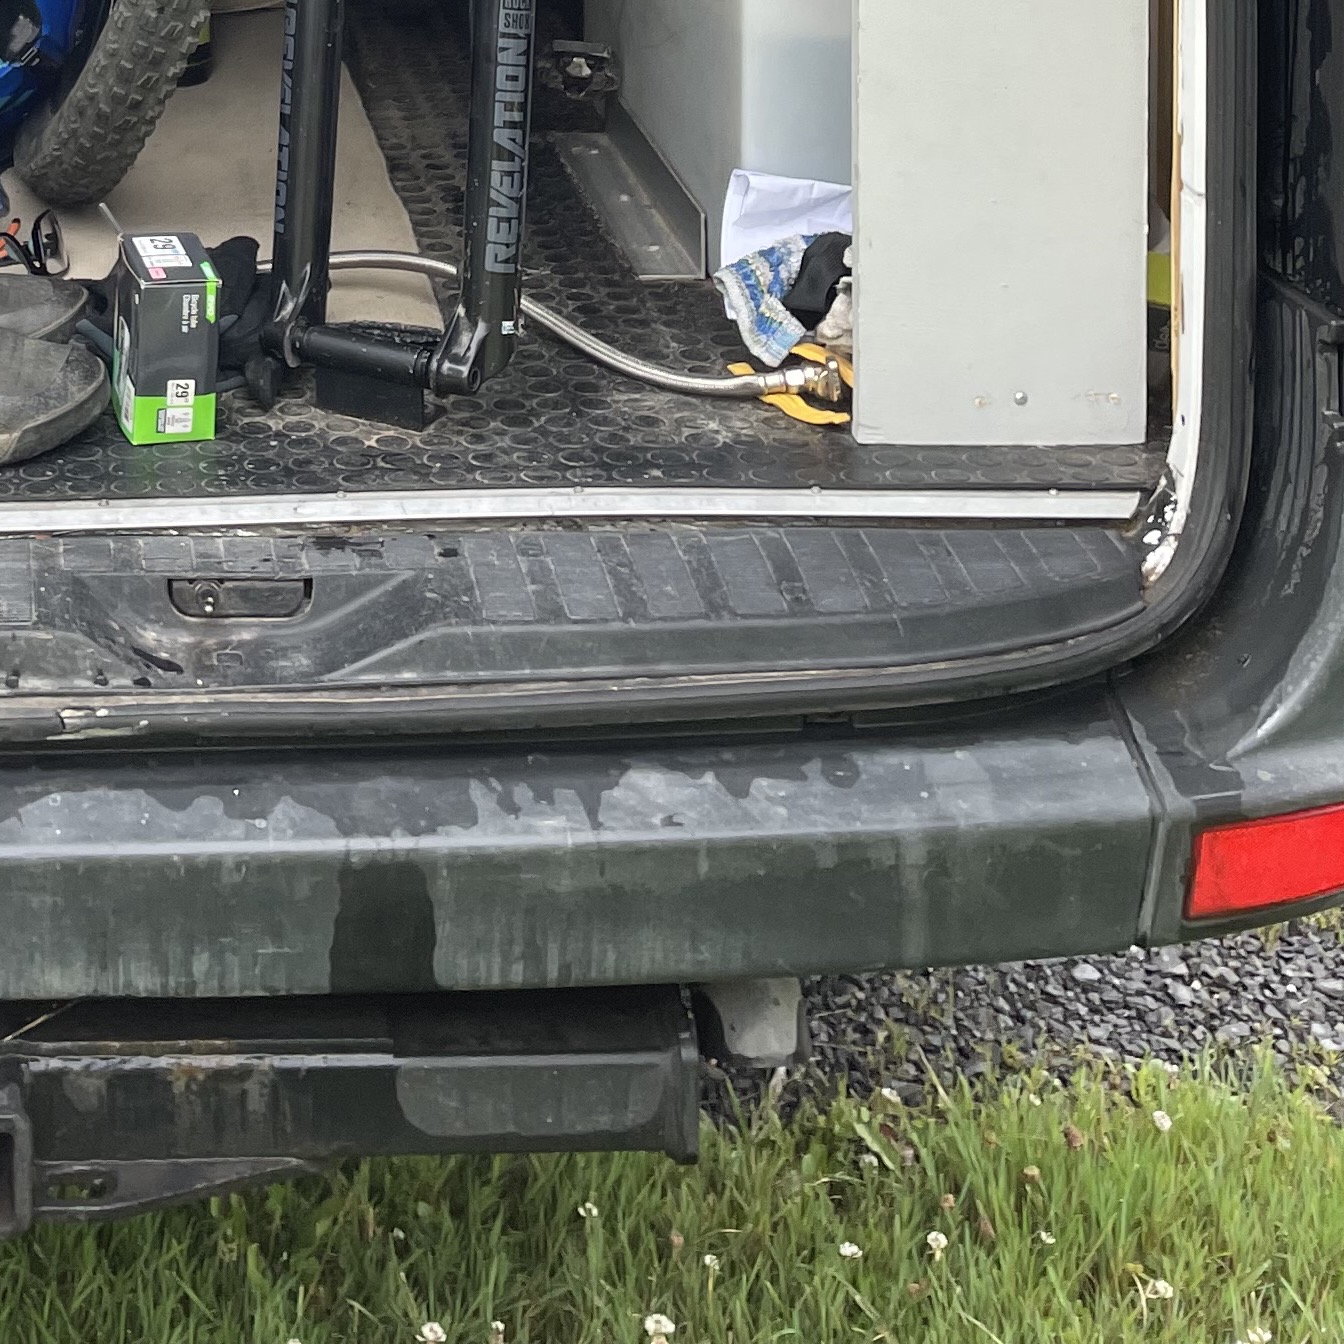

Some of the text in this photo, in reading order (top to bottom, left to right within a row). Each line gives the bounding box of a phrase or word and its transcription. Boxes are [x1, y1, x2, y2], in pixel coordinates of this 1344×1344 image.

[503, 12, 530, 30] SHOX
[485, 38, 529, 274] REVELATION
[175, 382, 189, 399] 29
